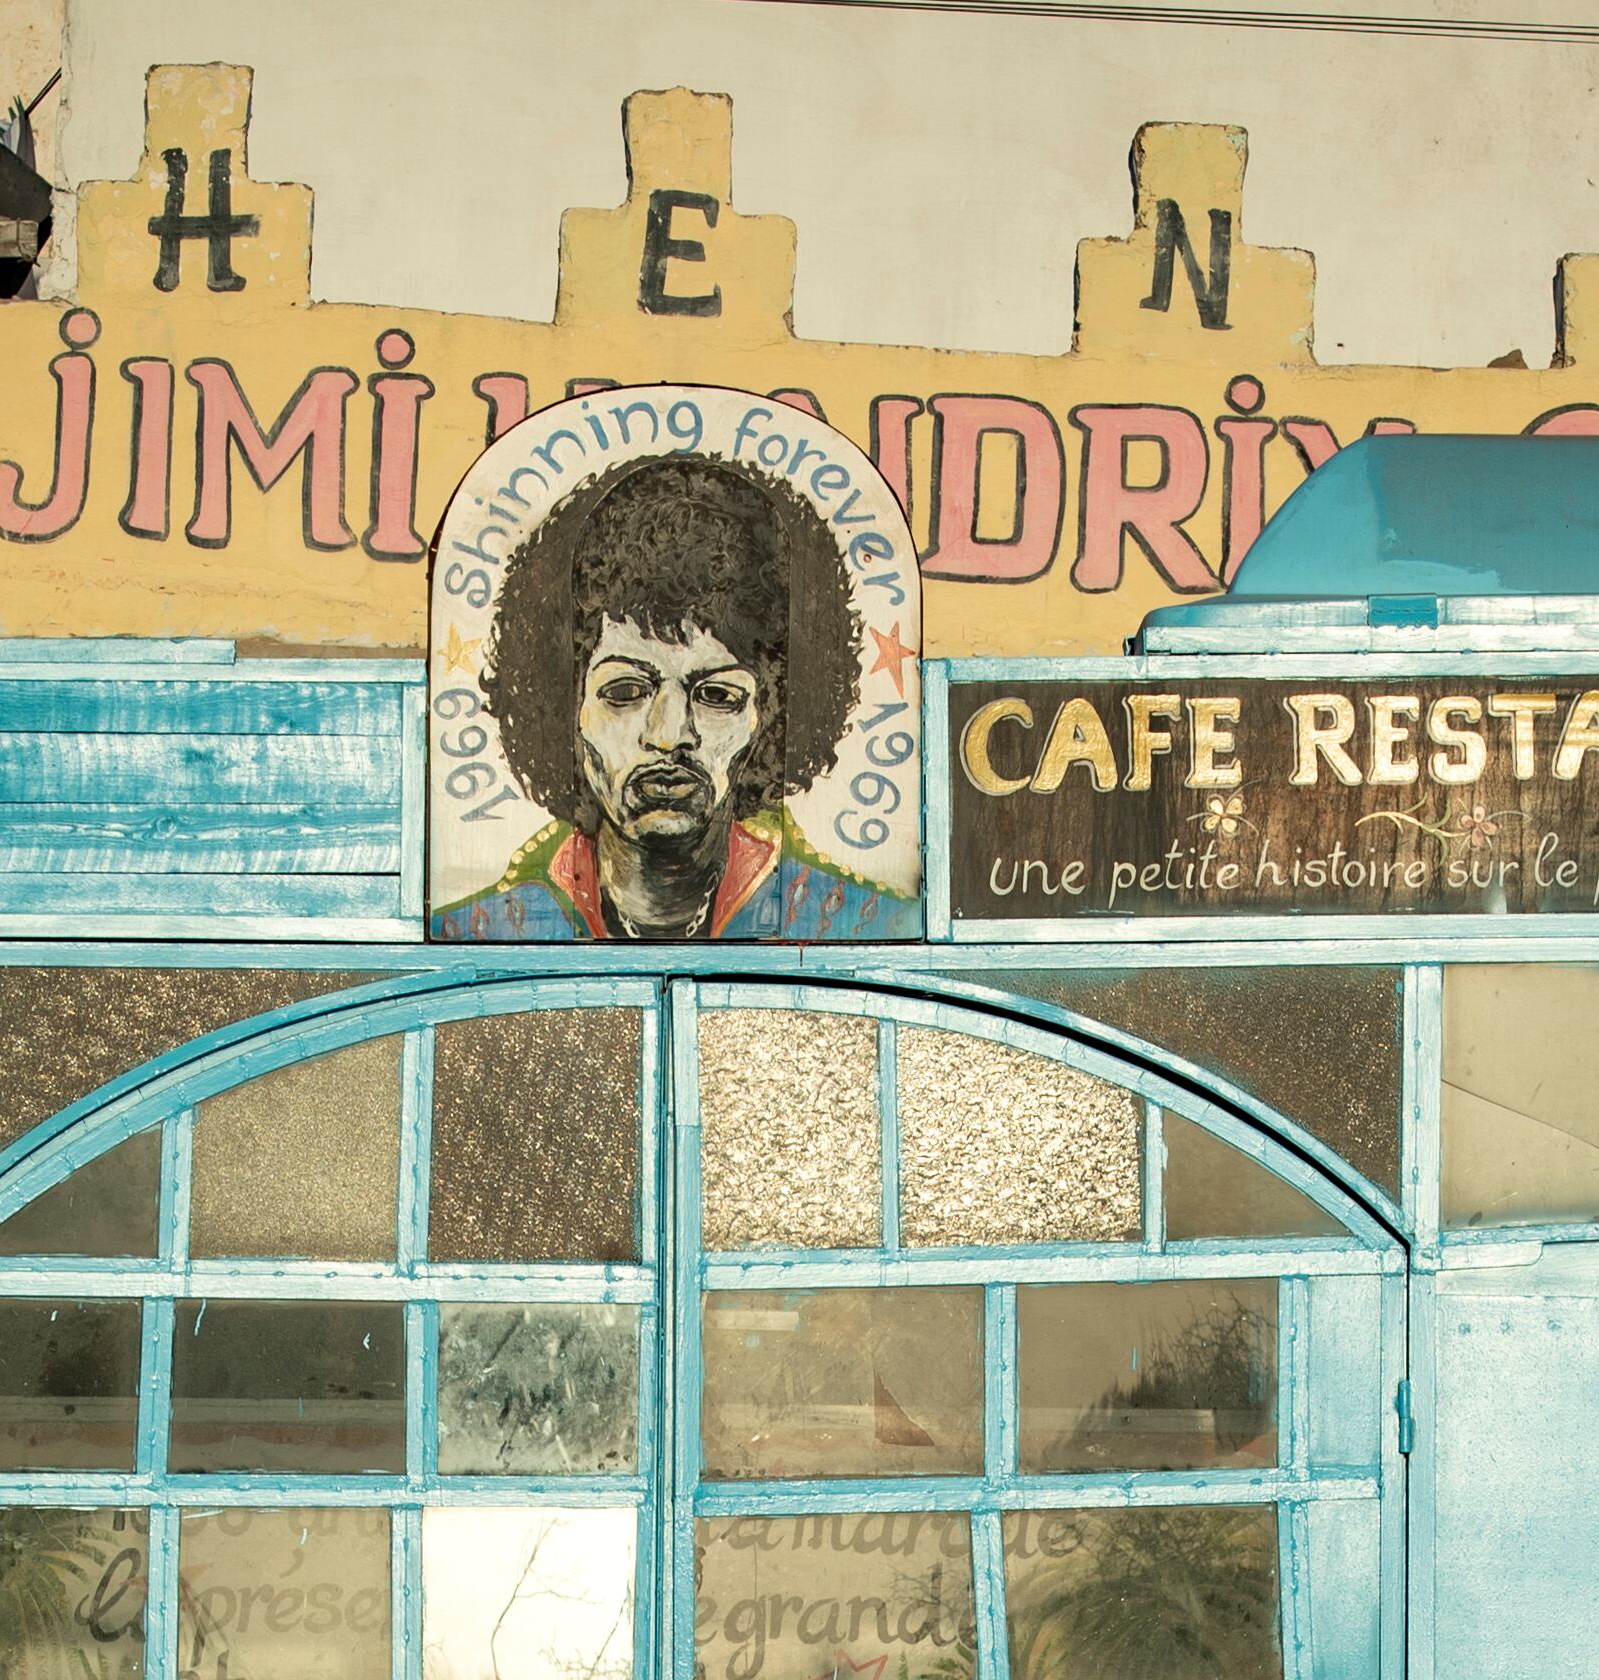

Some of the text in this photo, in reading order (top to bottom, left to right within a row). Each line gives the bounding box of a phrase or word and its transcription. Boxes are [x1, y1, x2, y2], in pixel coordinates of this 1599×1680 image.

[734, 407, 906, 606] forever
[433, 687, 521, 823] 1969
[834, 702, 914, 850] 1969
[959, 694, 1243, 796] CAFE
[989, 857, 1087, 895] une
[1108, 838, 1242, 909] petite
[1254, 838, 1427, 889] histoire
[1446, 856, 1520, 888] sur
[1534, 832, 1579, 888] le
